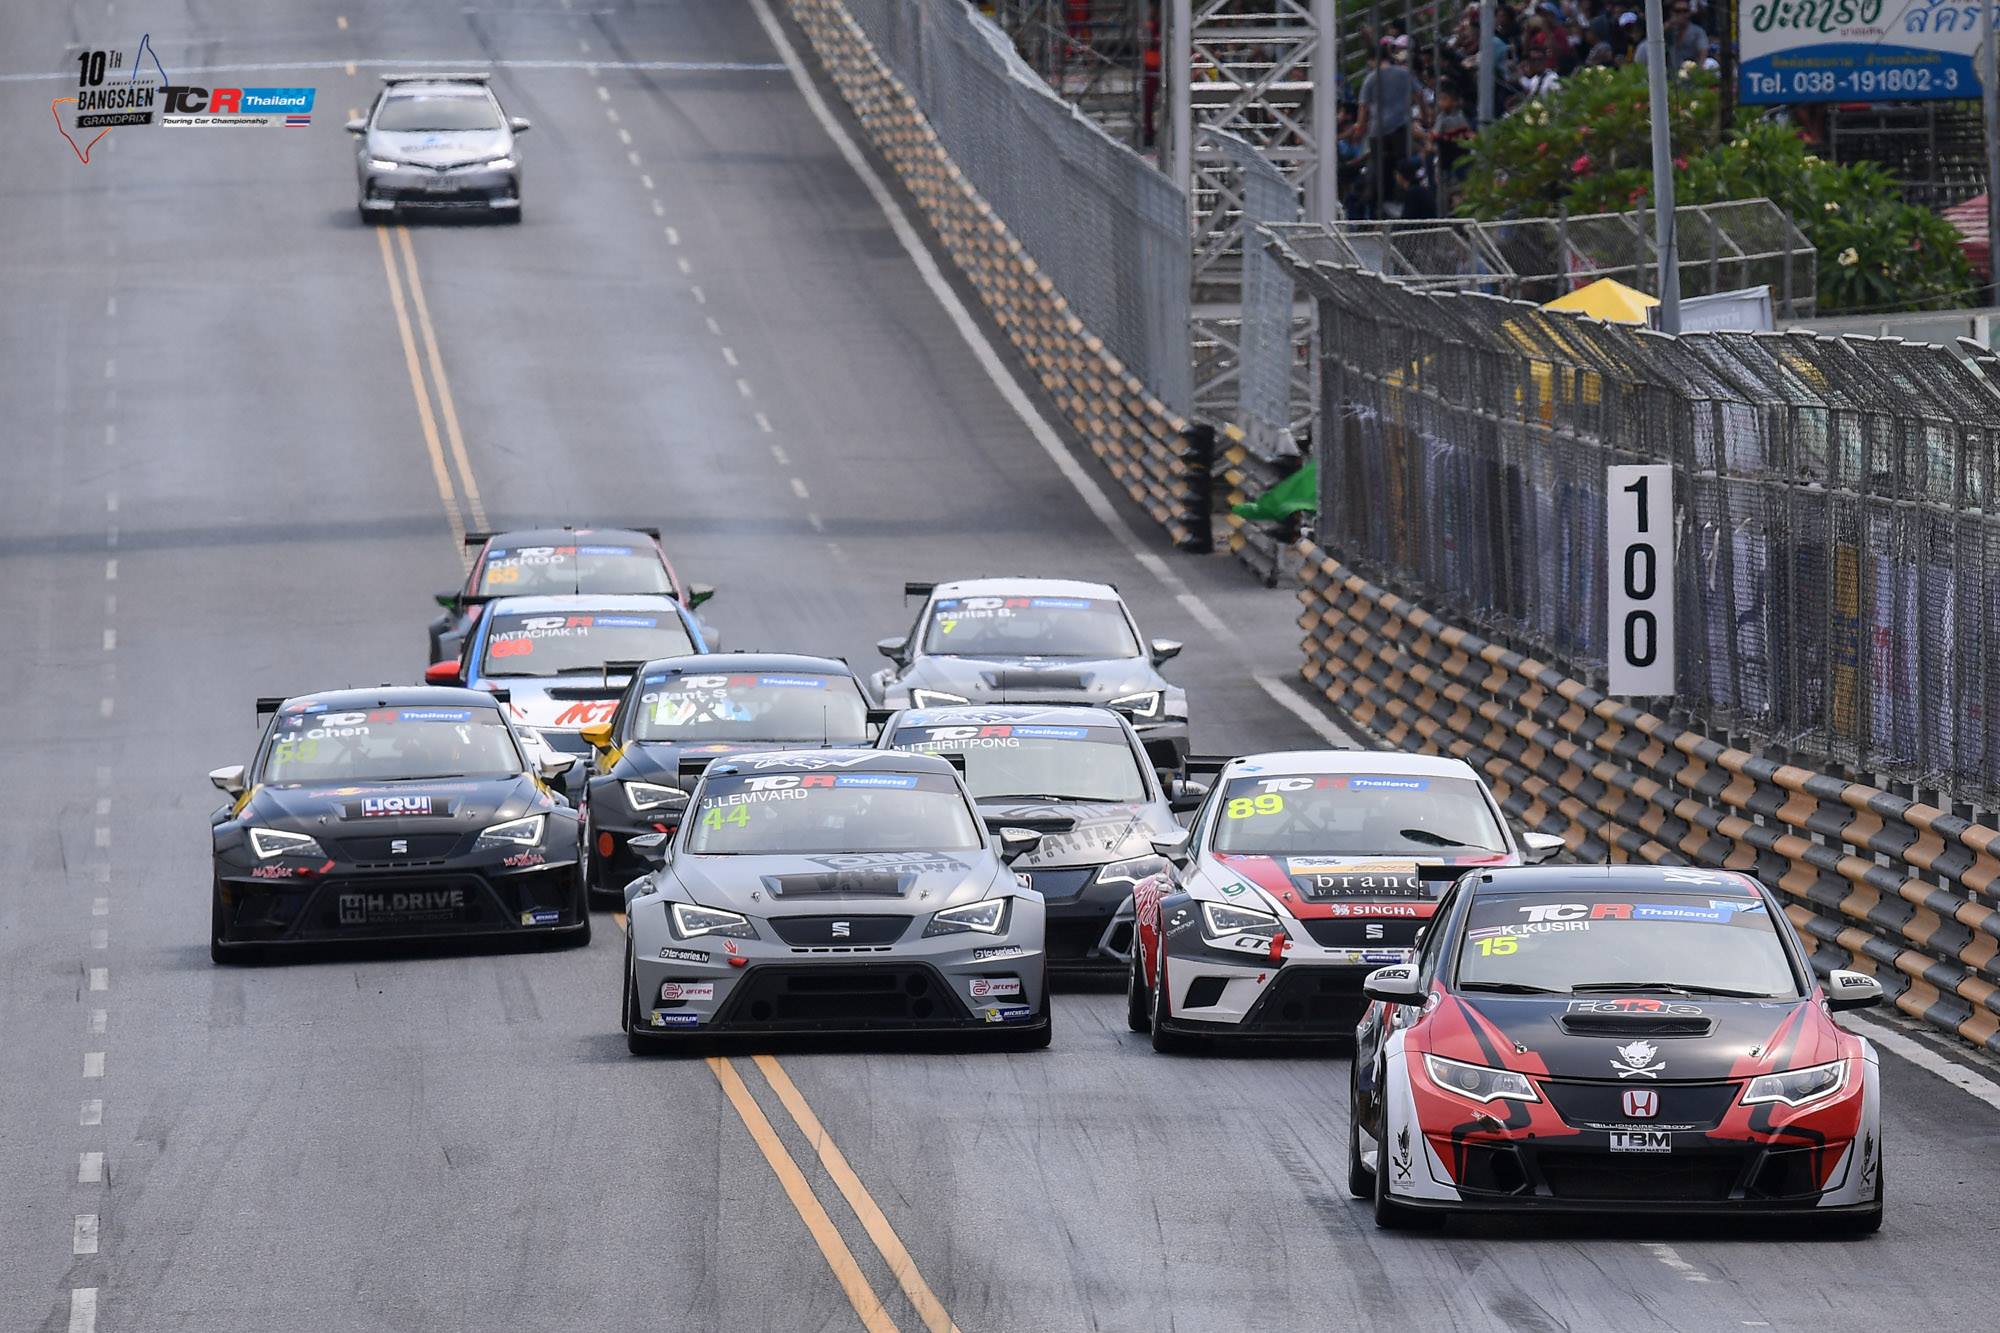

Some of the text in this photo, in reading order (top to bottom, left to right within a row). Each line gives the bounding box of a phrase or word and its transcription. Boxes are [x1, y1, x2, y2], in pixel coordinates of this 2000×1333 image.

[1750, 72, 1786, 93] Tel.
[940, 620, 957, 635] 7
[403, 712, 464, 721] Thailand
[307, 727, 370, 740] Chen
[926, 726, 1079, 741] TCR Thailand
[744, 776, 908, 791] TCR Thailand
[1353, 780, 1420, 788] Thailand
[365, 797, 428, 812] LIQUI
[704, 788, 809, 809] J.LEMVARD
[1227, 793, 1285, 819] 89
[702, 805, 751, 831] 44
[1353, 905, 1416, 916] SINGHA
[1519, 903, 1720, 923] TCR Thailand
[1502, 920, 1590, 936] K.KUSIRI
[1474, 937, 1518, 956] 15
[1611, 1132, 1670, 1147] TBM
